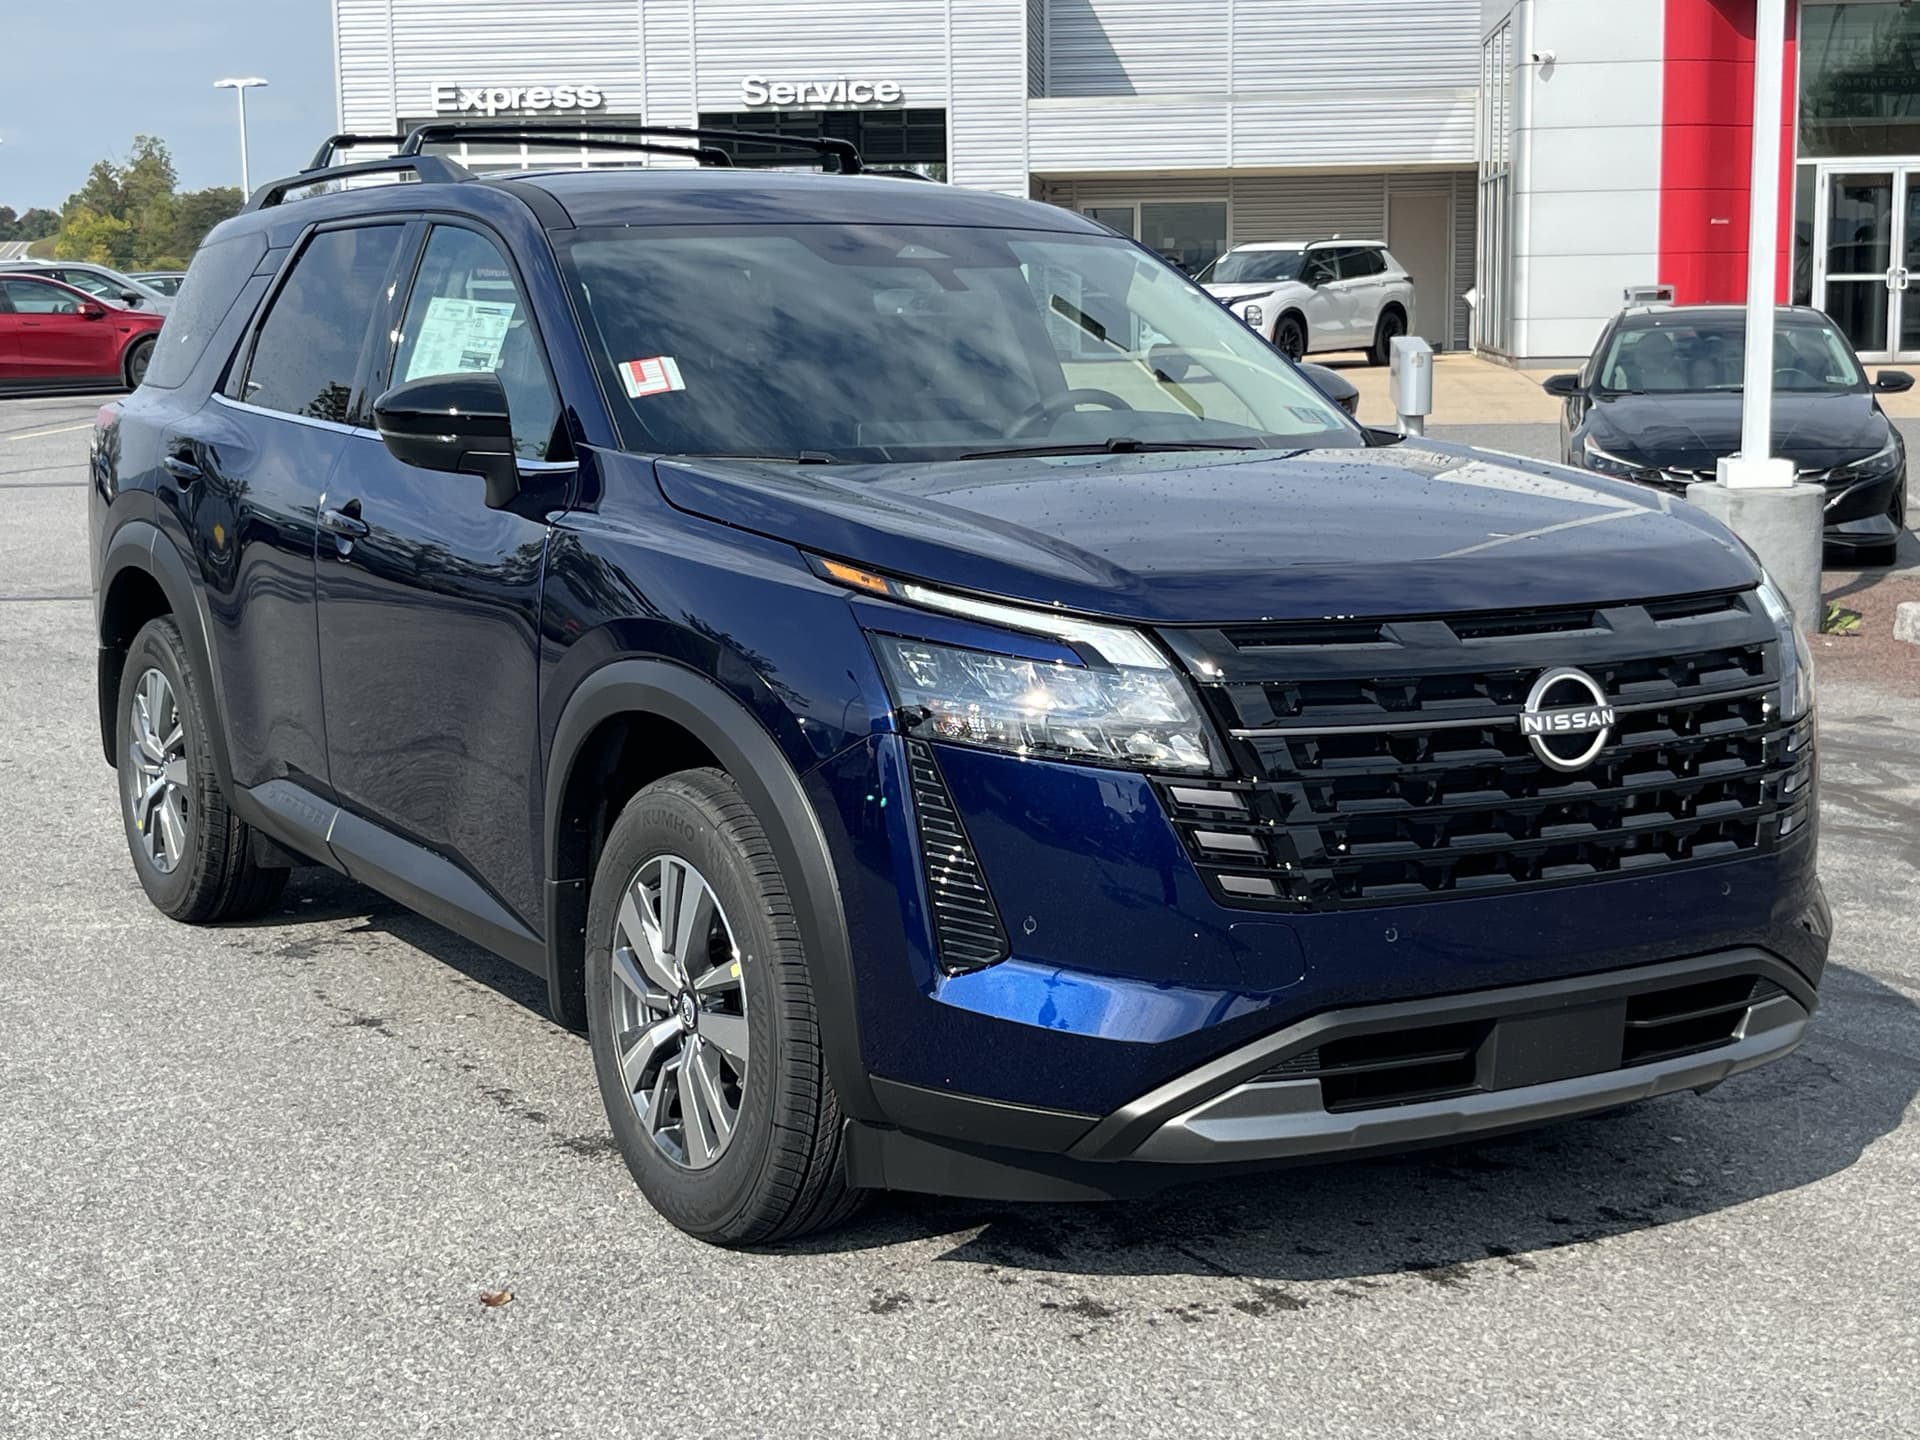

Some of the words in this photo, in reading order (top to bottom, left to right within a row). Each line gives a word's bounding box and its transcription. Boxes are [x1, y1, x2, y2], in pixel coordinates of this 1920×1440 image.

[430, 81, 602, 117] Express
[741, 74, 901, 106] Service
[1524, 709, 1614, 732] NISSAN
[643, 809, 694, 841] KUMHO
